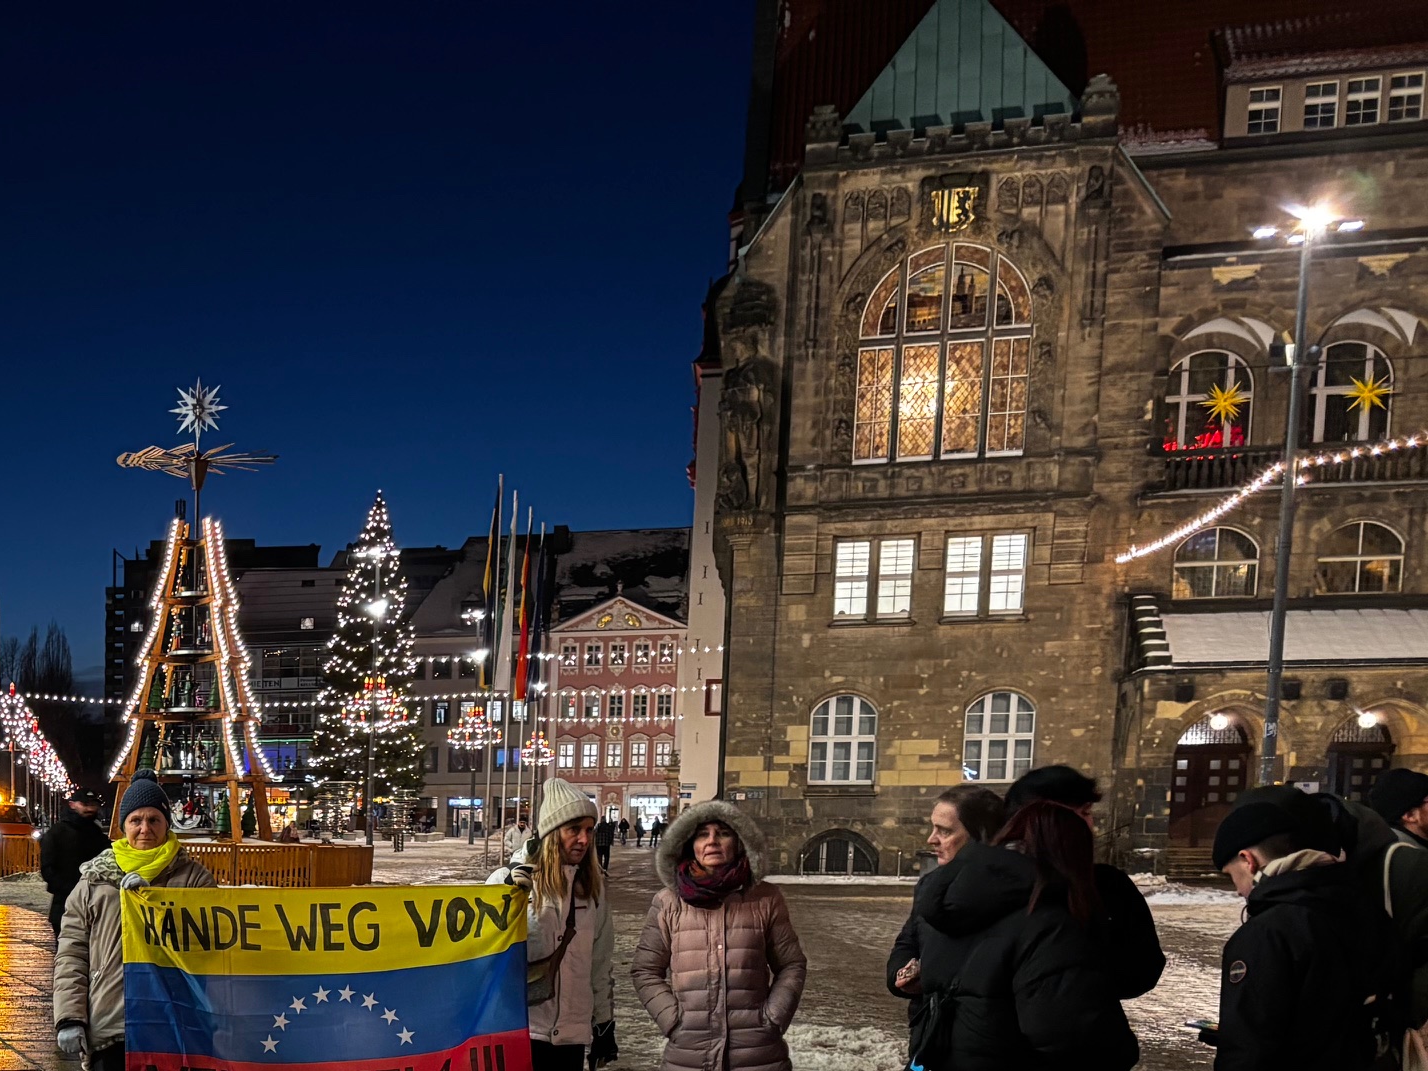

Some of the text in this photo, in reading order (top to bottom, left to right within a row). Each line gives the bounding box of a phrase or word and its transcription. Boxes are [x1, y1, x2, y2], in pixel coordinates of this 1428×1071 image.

[142, 893, 513, 952] HÄNDE WEG VON
